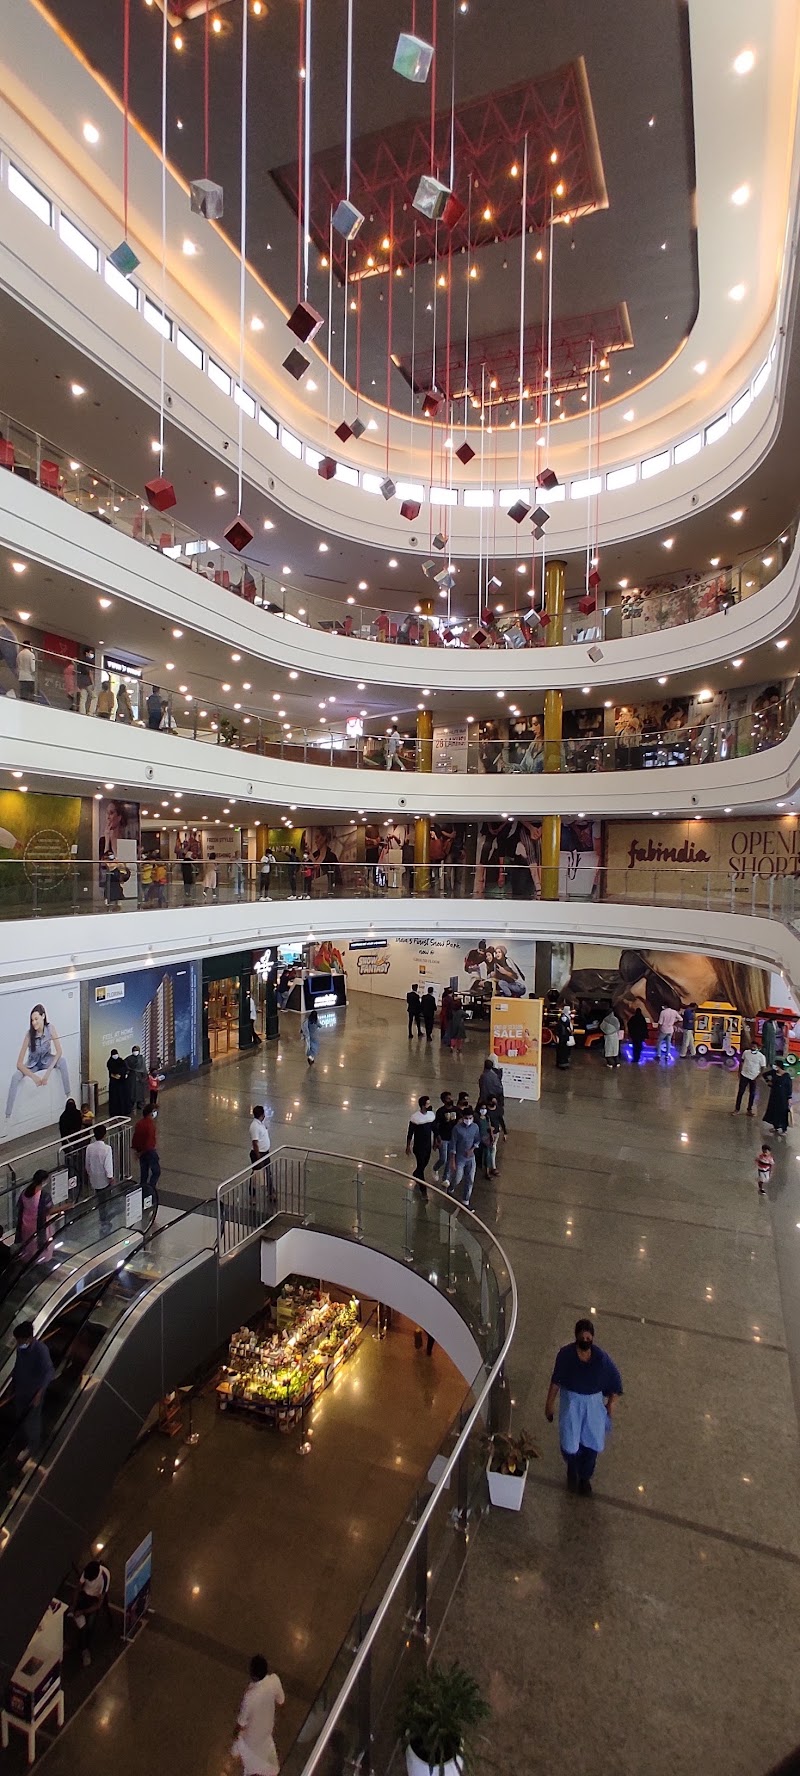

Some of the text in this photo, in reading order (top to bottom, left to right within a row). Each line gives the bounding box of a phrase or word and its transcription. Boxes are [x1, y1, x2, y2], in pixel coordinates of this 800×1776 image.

[628, 838, 712, 869] fabindia
[730, 830, 800, 855] OPENI
[493, 1029, 523, 1038] SALE
